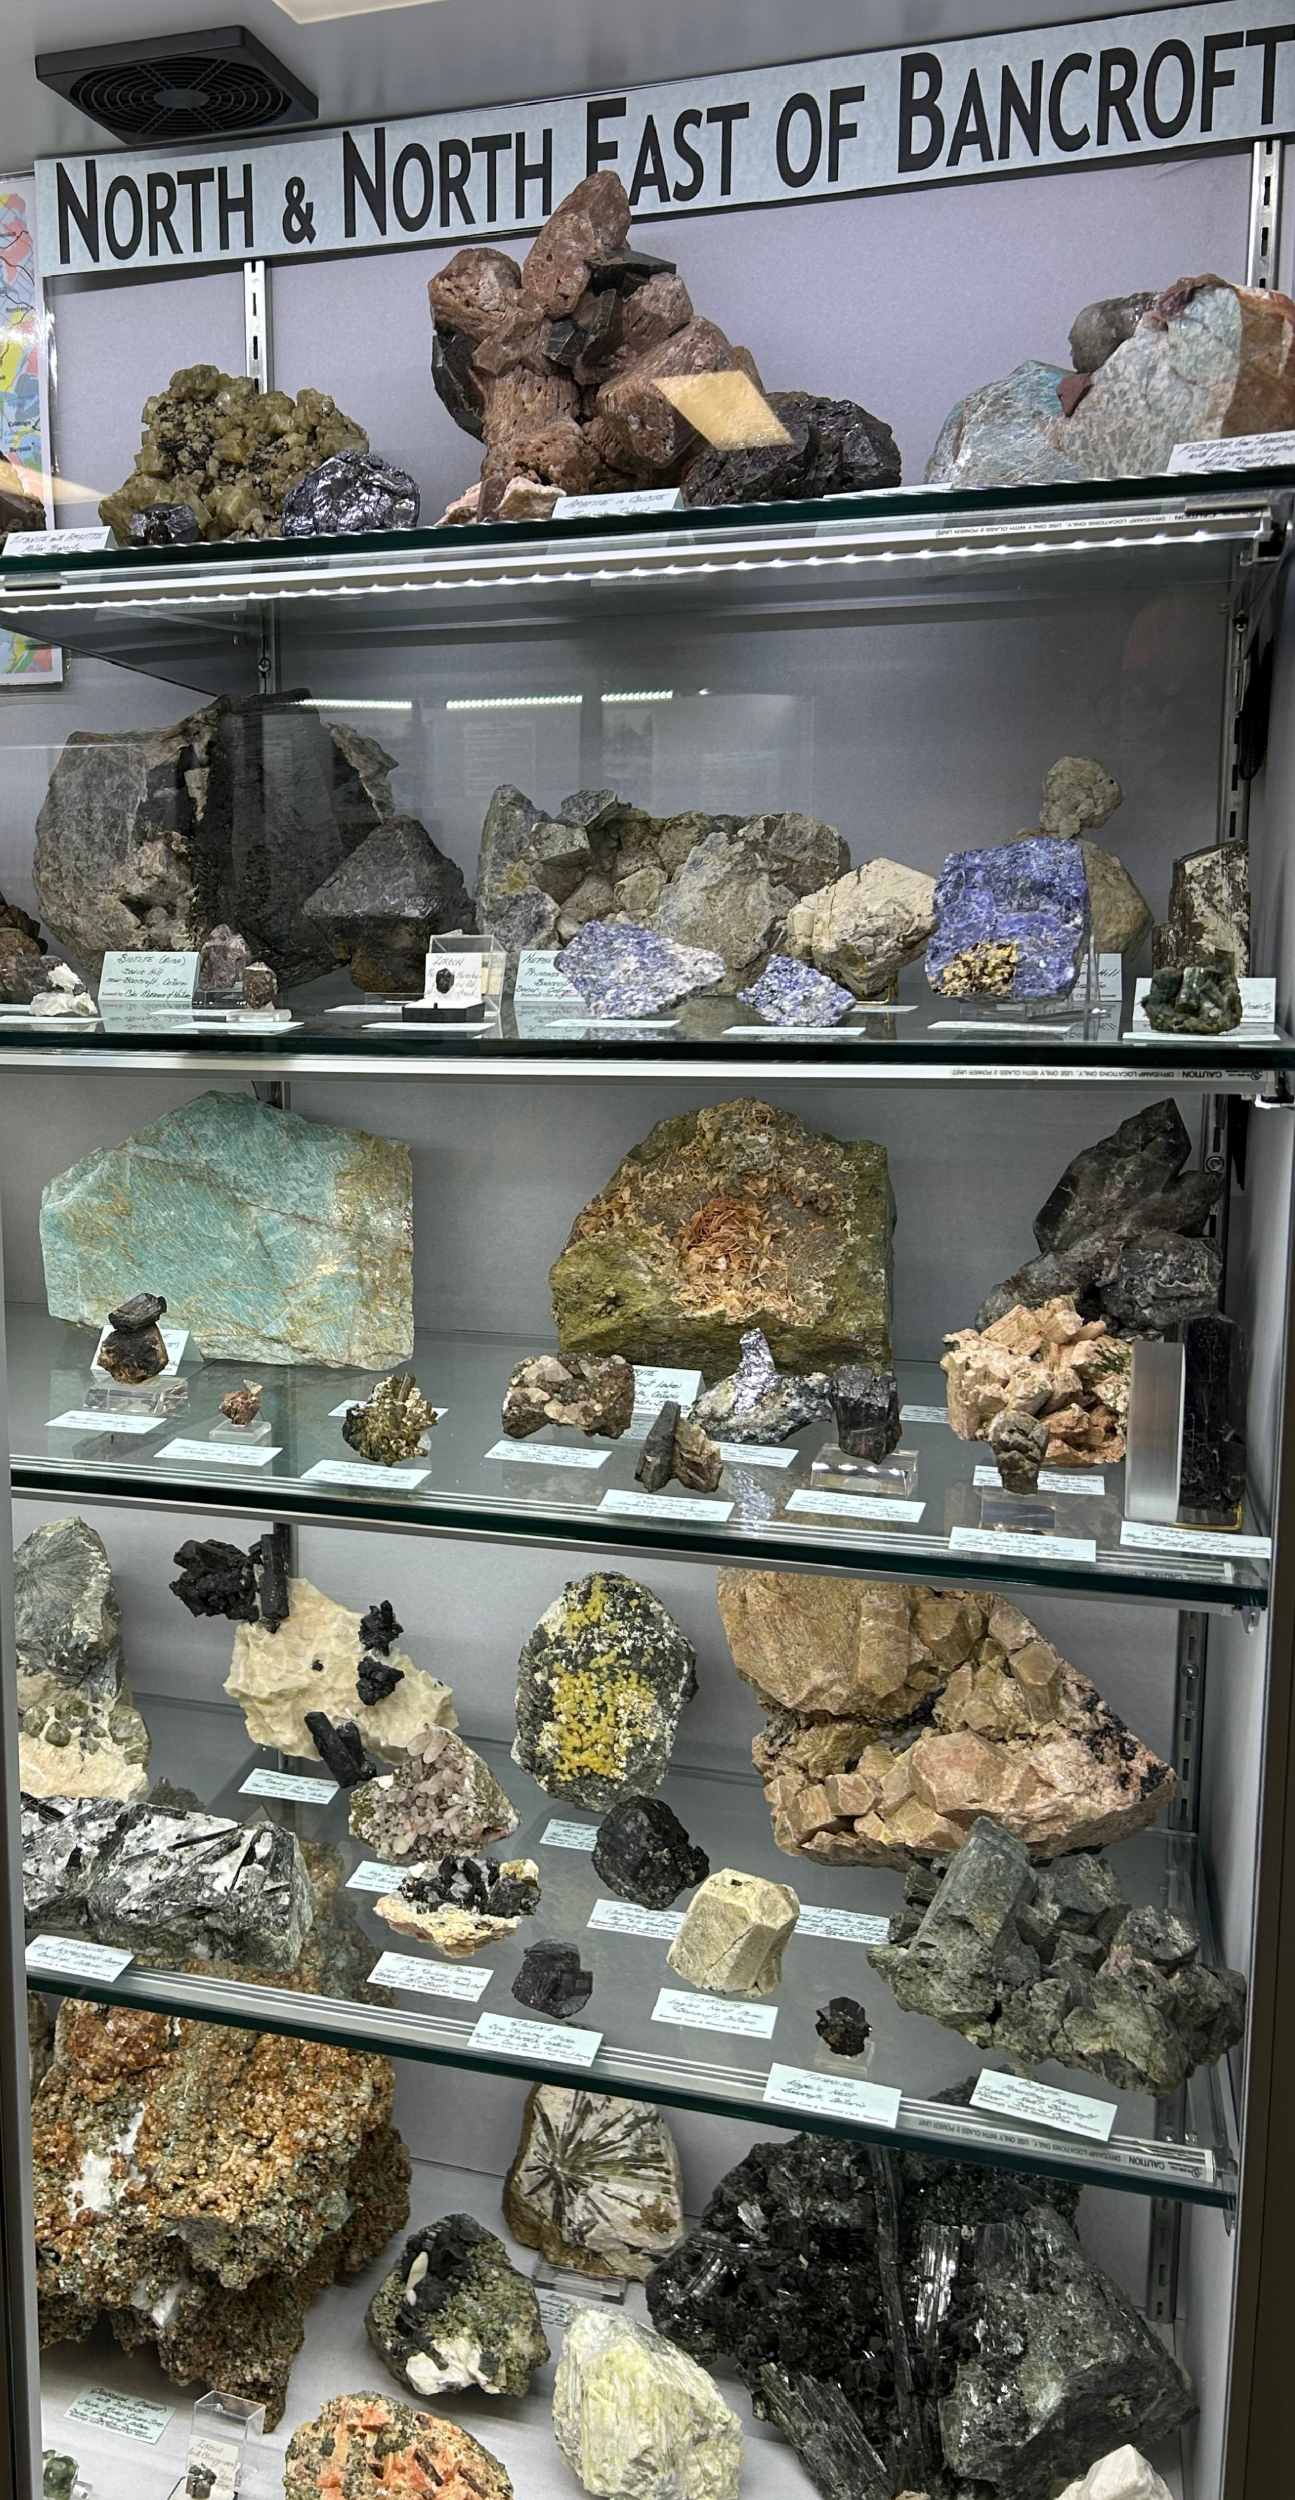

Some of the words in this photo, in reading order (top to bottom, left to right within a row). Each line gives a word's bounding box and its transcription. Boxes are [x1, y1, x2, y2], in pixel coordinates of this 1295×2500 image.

[55, 159, 254, 265] NORTH
[282, 175, 317, 245] &
[342, 127, 552, 238] NORTH
[586, 97, 750, 206] EAST
[776, 85, 865, 188] OF
[898, 24, 1295, 173] BANCROFT
